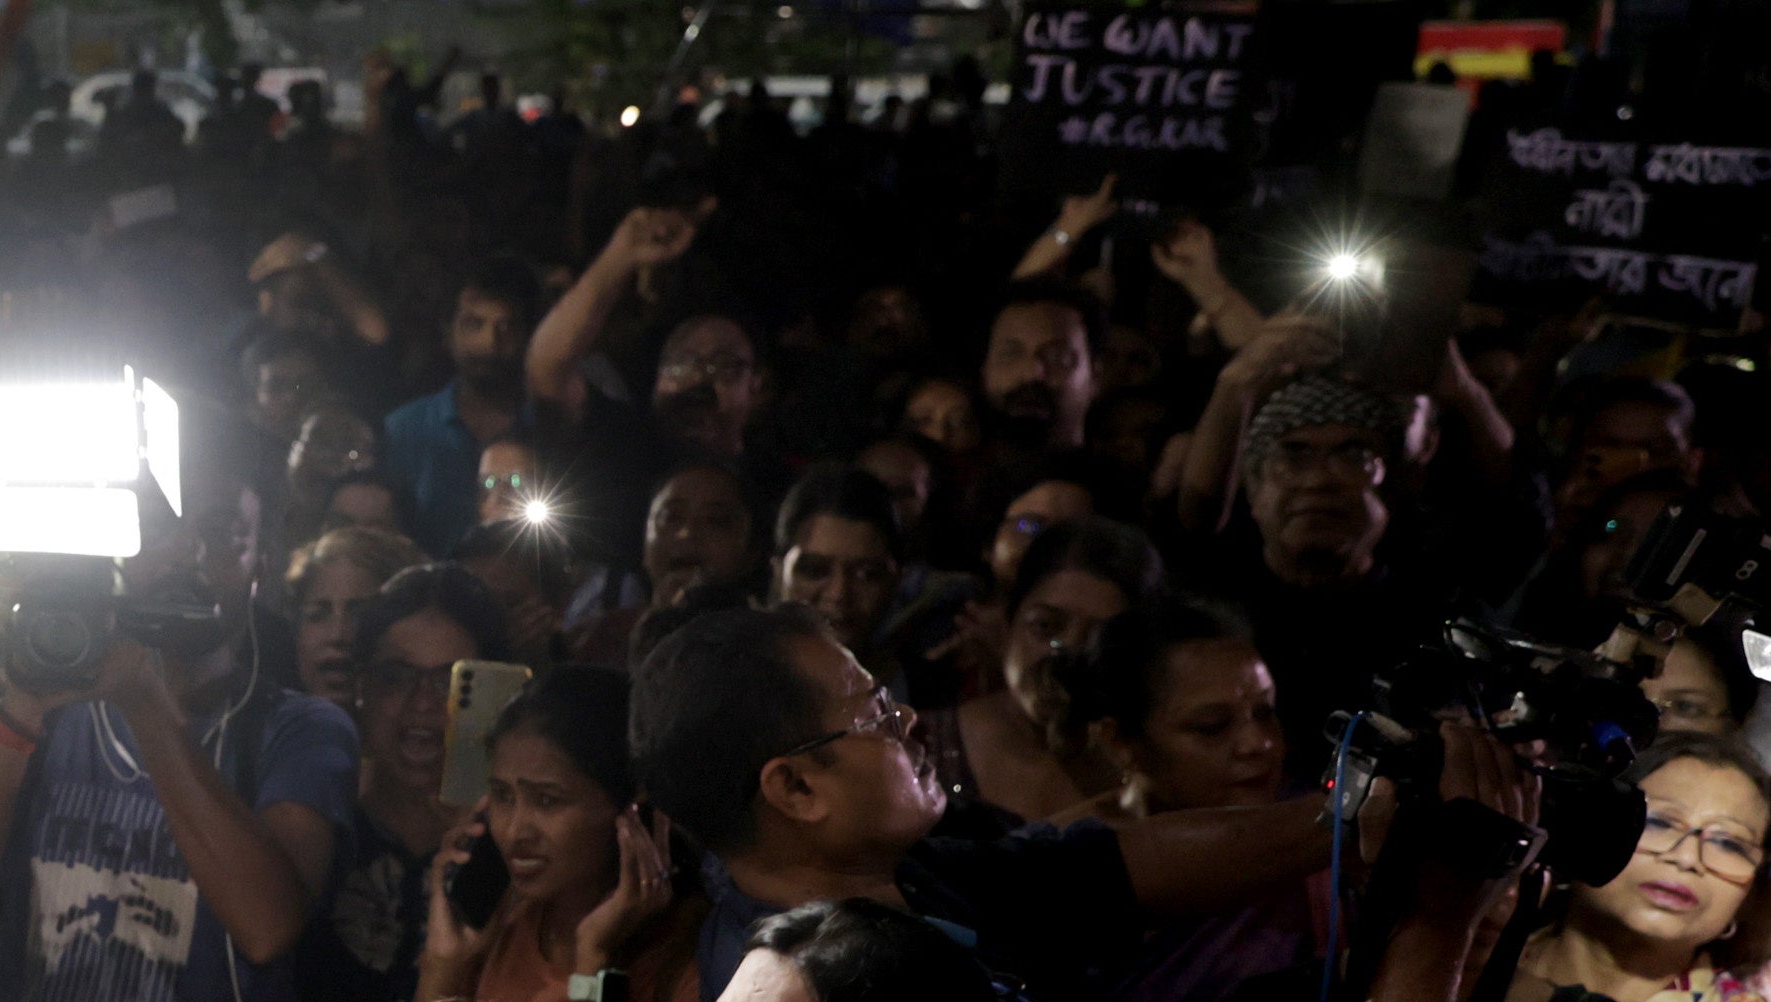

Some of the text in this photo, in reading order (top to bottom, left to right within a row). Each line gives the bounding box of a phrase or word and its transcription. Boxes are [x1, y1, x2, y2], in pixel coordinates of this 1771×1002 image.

[1024, 10, 1253, 60] WE WANT
[1024, 54, 1245, 108] JUSTICE
